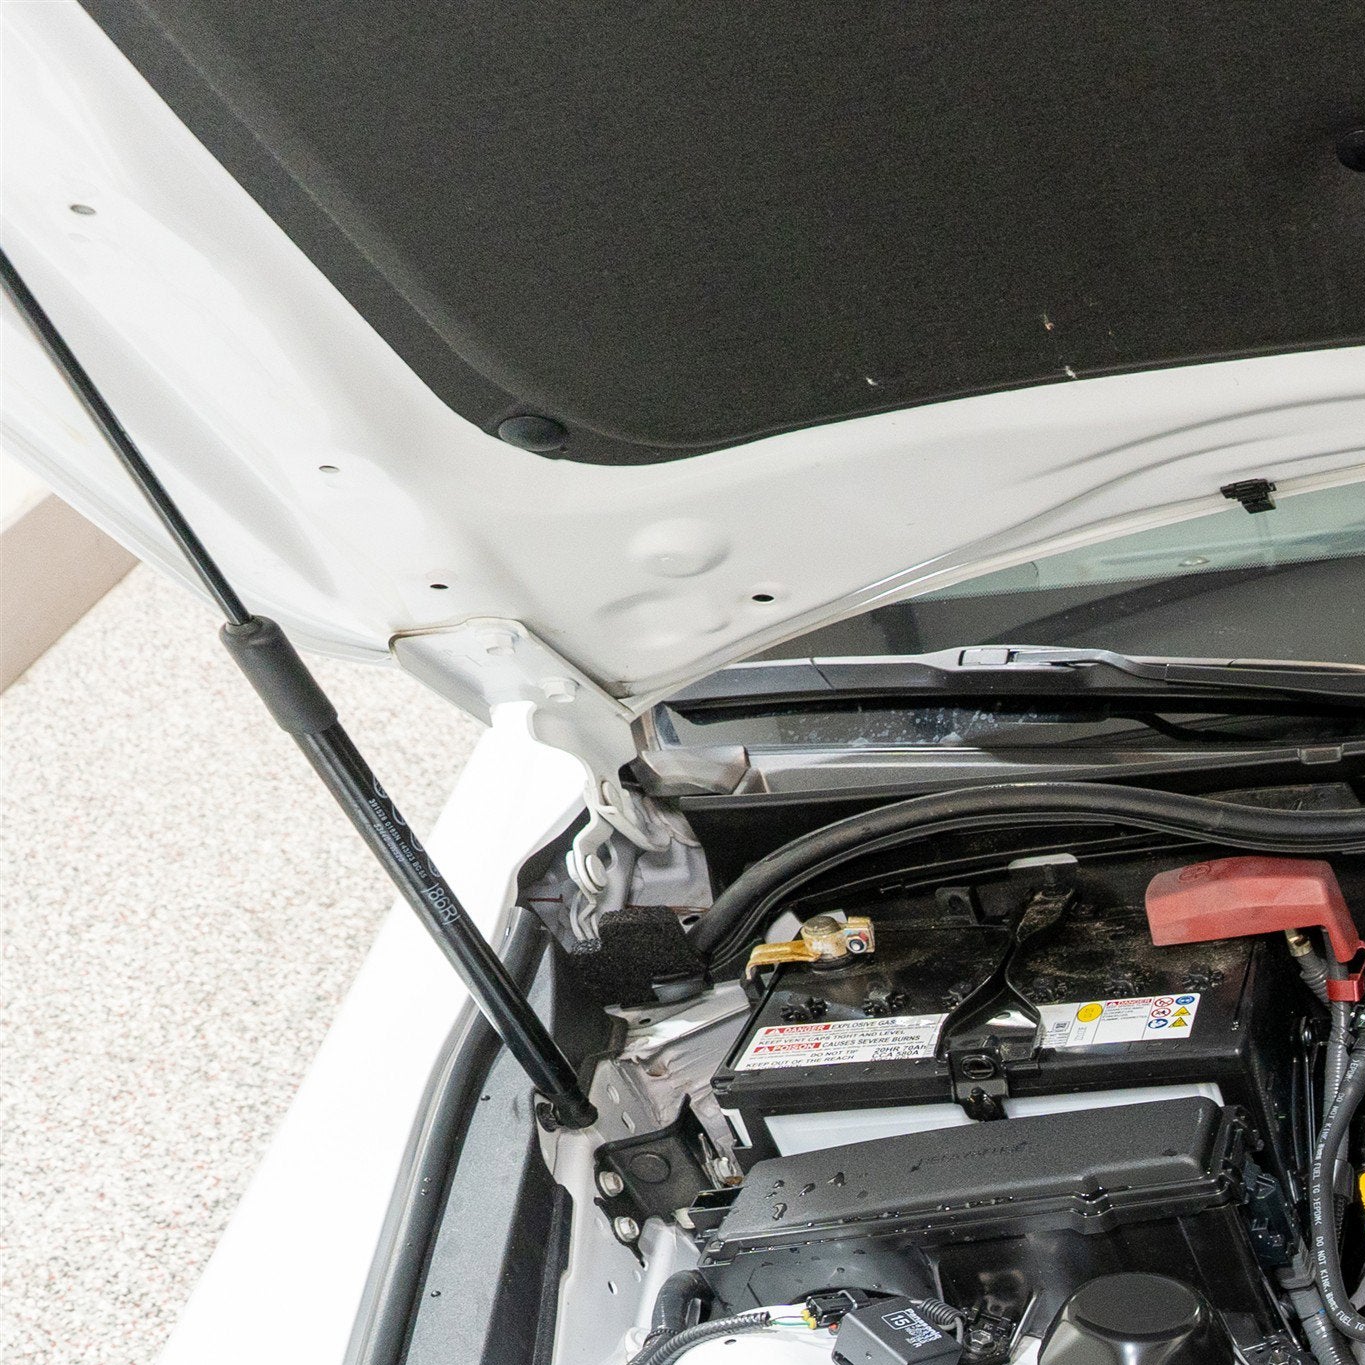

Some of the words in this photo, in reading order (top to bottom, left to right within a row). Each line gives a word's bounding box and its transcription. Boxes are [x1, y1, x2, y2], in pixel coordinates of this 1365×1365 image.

[784, 1025, 826, 1033] DANGER
[831, 1021, 874, 1029] EXPLOSIVE
[773, 1042, 814, 1052] POISON
[822, 1040, 855, 1048] CAUSES
[857, 1036, 890, 1045] SEVERE
[891, 1035, 921, 1043] BURNS
[874, 1045, 900, 1053] 20HR
[1317, 1250, 1327, 1266] NOT
[890, 1315, 910, 1327] 15
[1336, 1309, 1352, 1327] FUEL
